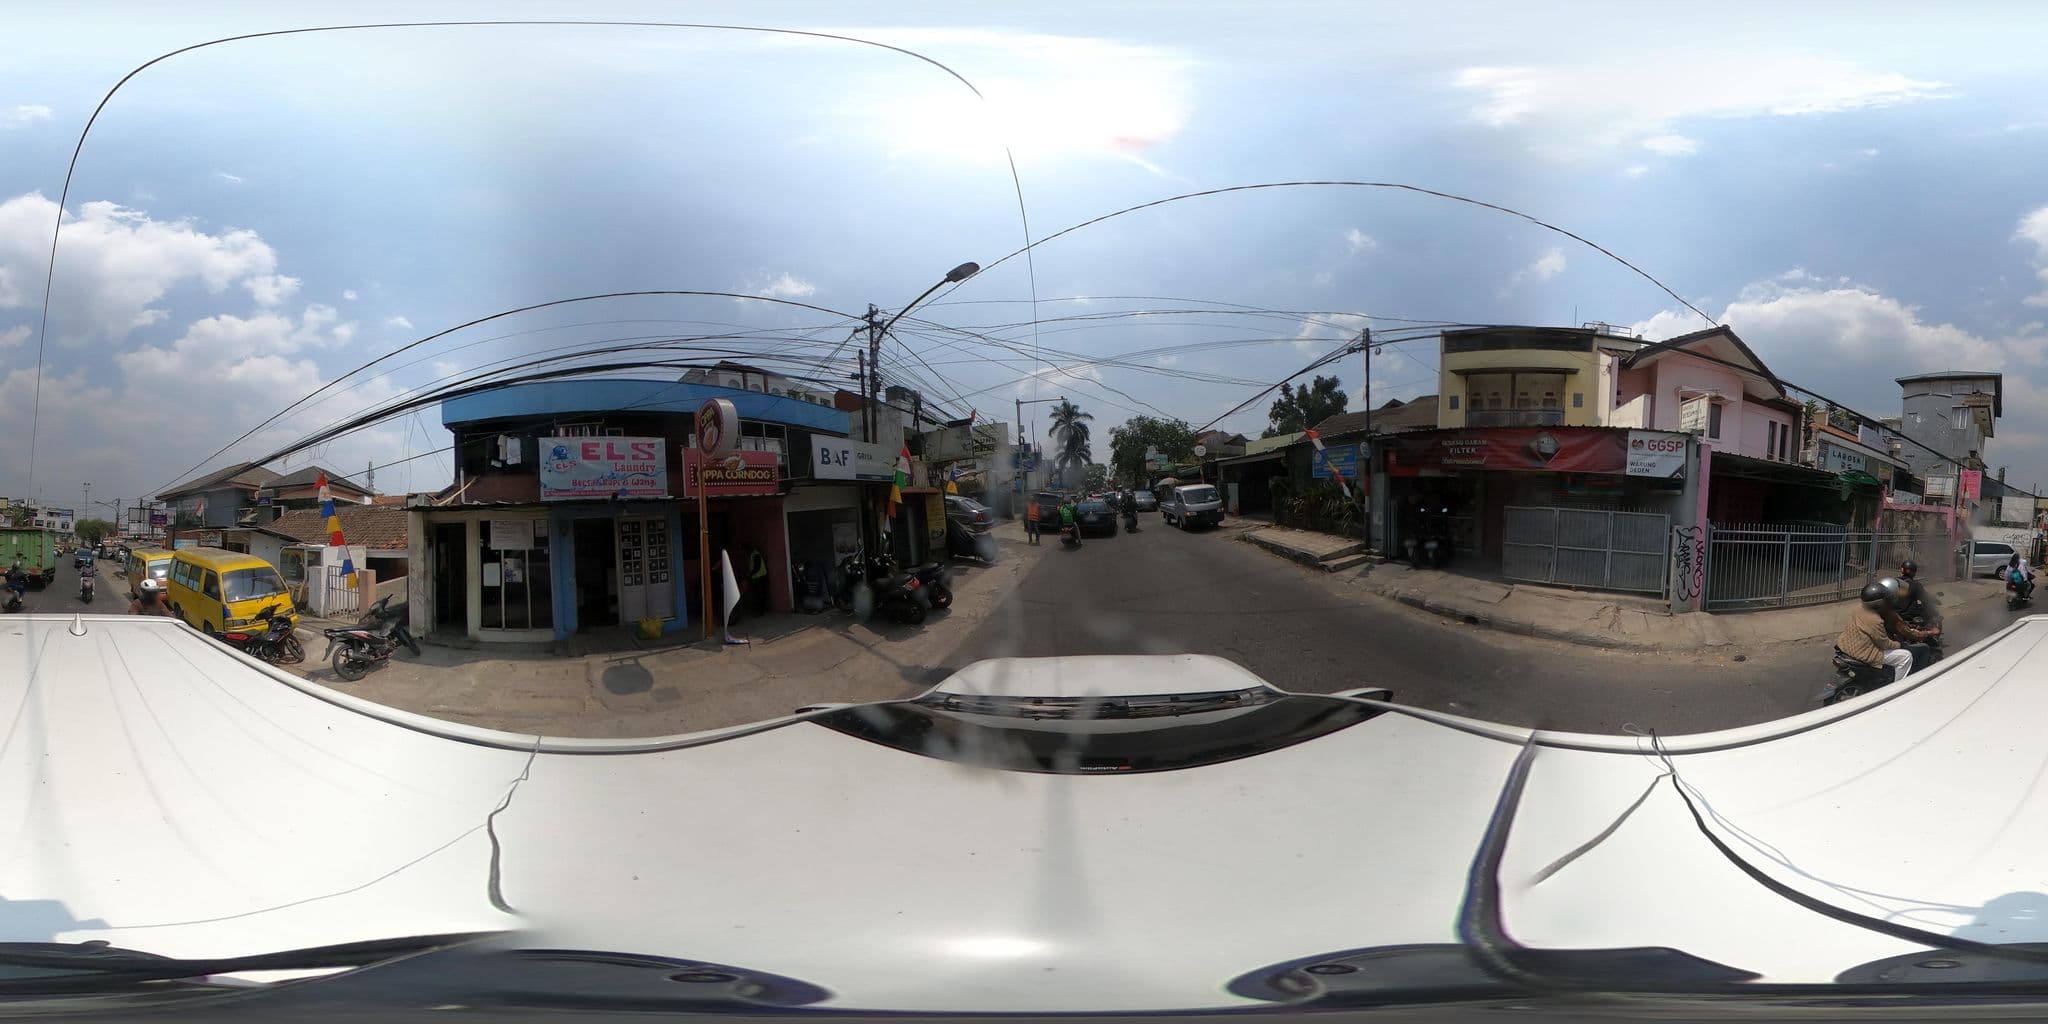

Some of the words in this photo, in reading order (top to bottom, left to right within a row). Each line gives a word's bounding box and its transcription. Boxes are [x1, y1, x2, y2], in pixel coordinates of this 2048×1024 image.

[581, 442, 656, 461] ELS
[1647, 439, 1684, 452] GGSP
[820, 447, 849, 466] BAF
[614, 462, 656, 474] Laundry
[725, 470, 771, 480] CORNDOG
